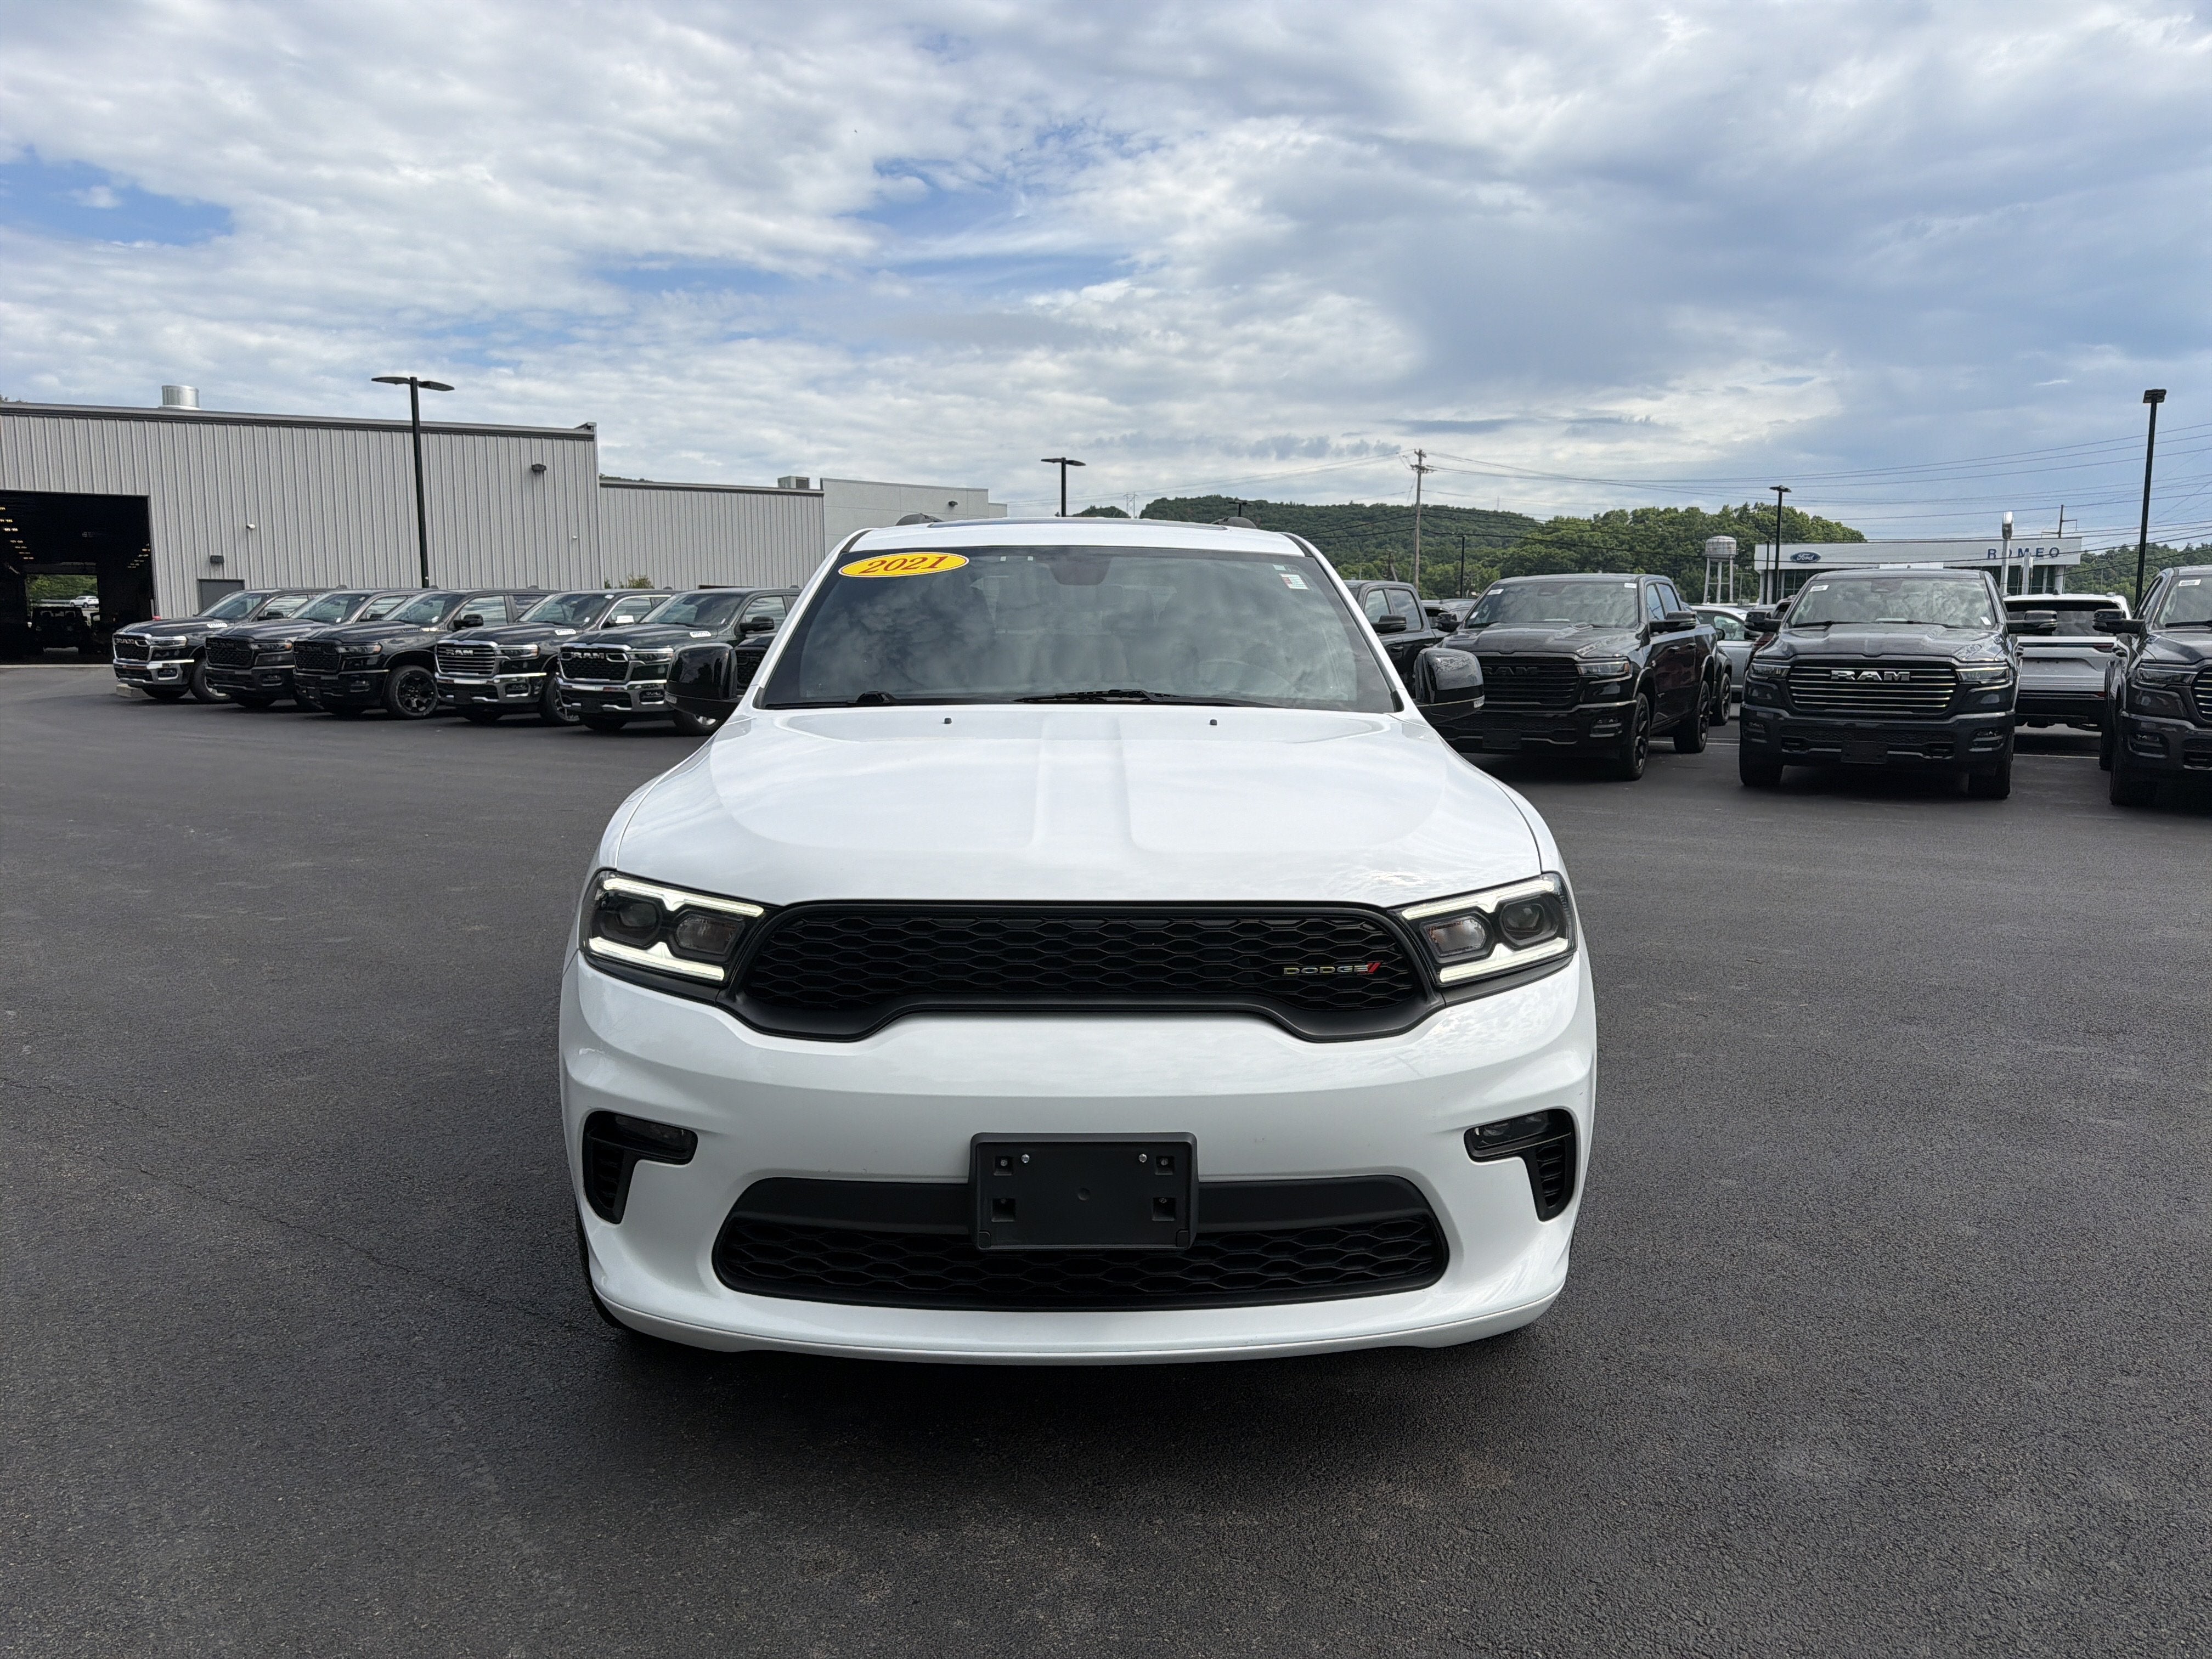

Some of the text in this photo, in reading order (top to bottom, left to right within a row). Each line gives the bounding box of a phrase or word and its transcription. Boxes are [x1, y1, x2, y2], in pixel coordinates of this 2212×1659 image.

[858, 556, 949, 574] 2021
[1831, 670, 1910, 681] RAM
[1283, 964, 1369, 975] DODGE
